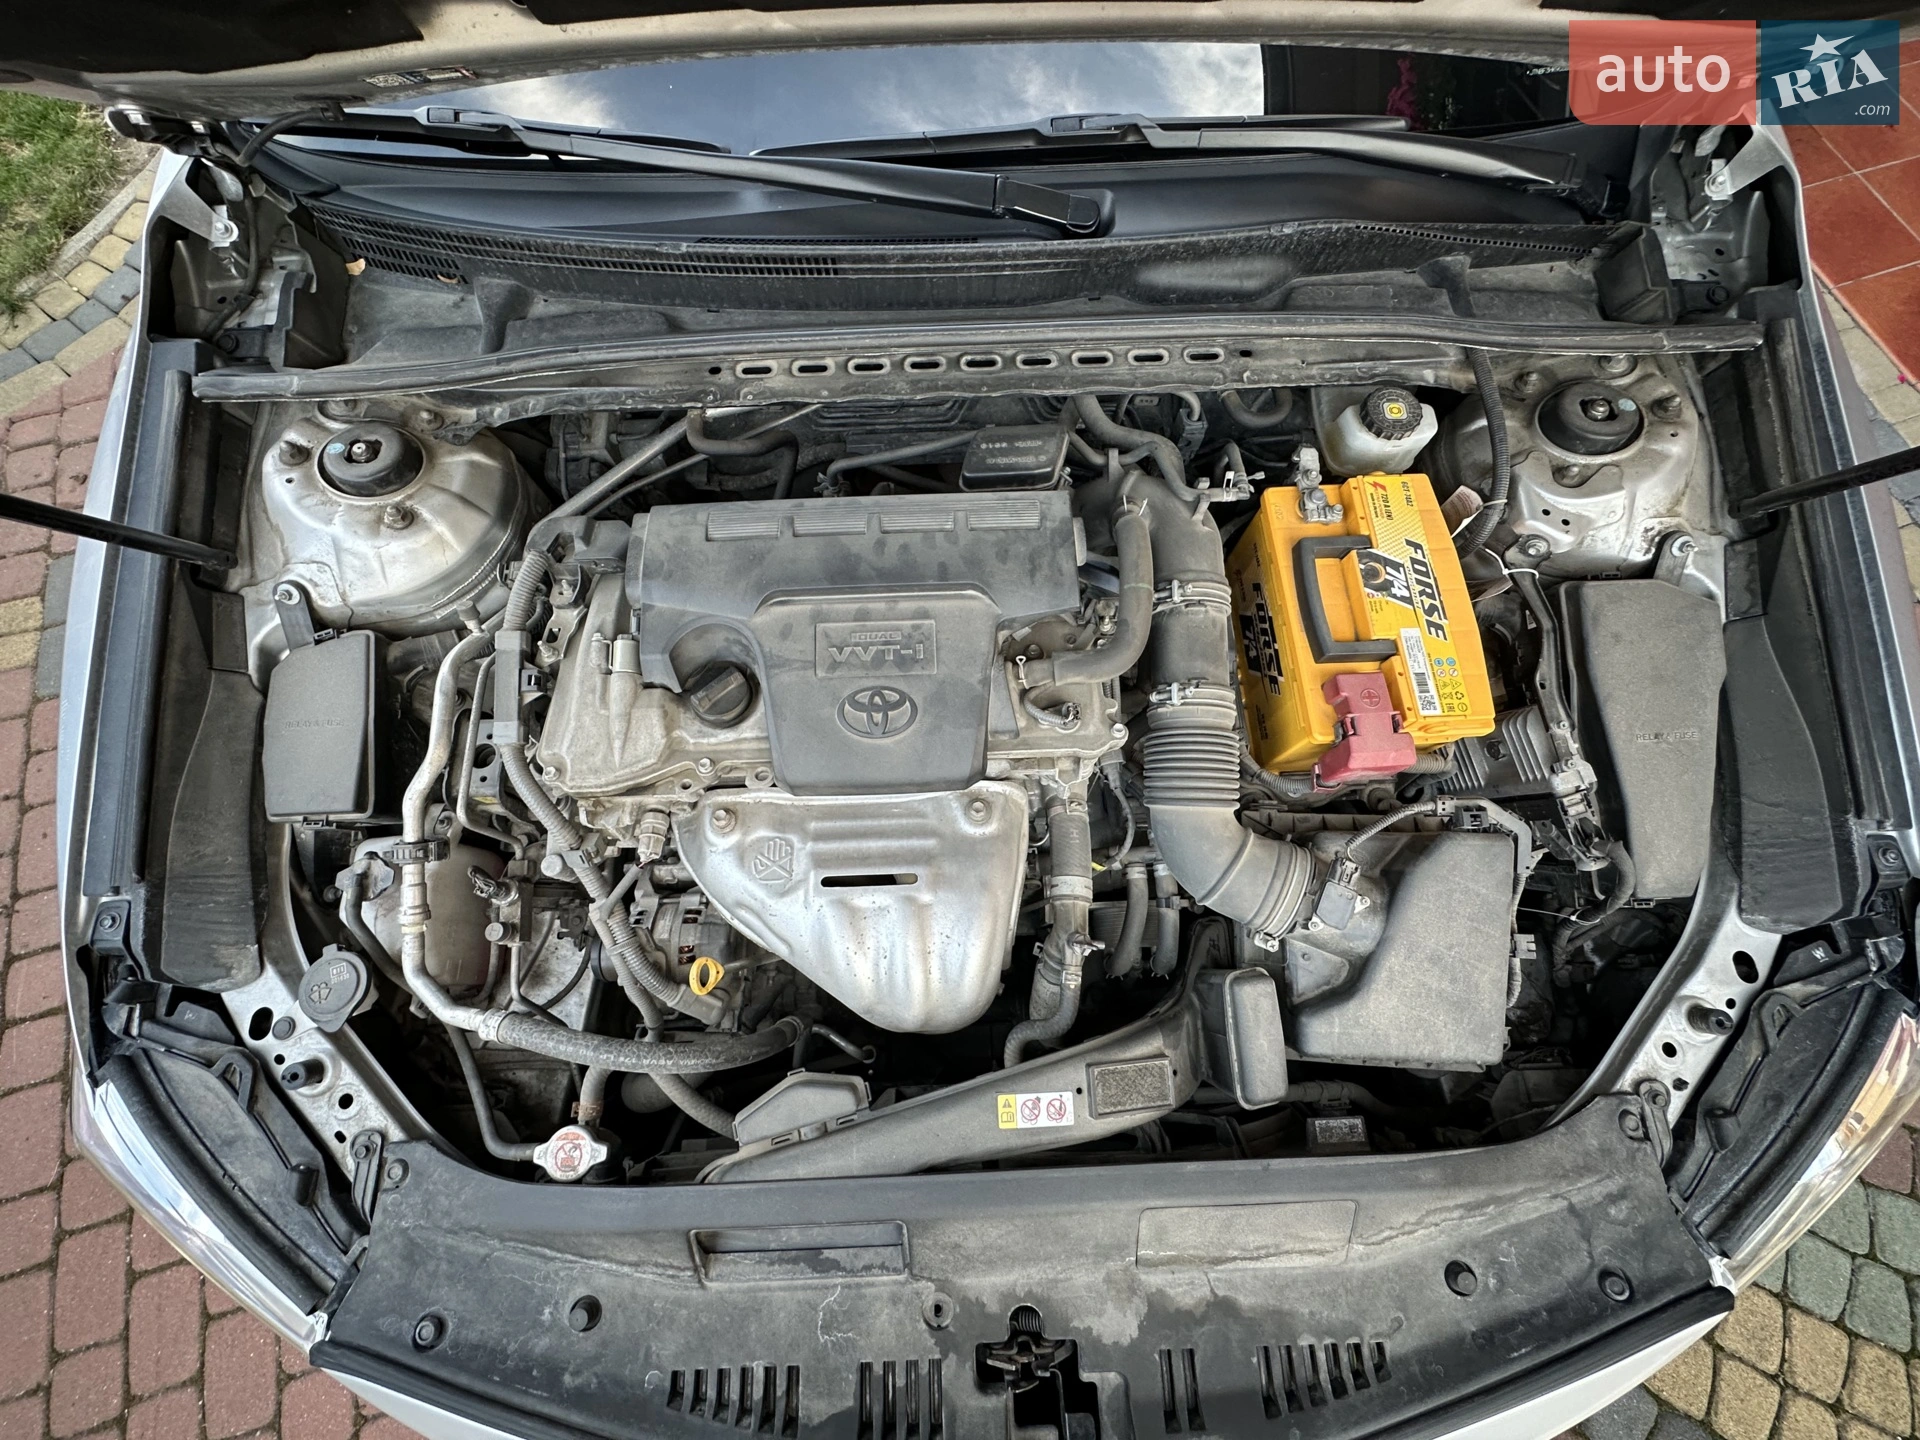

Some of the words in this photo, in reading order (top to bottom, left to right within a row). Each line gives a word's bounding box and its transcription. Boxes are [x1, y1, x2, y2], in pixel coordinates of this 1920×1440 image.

[1385, 566, 1411, 598] 74
[1404, 538, 1449, 642] FORSE
[1252, 583, 1281, 696] FORSE
[1636, 732, 1664, 741] RELAY
[1674, 731, 1698, 740] FUSE
